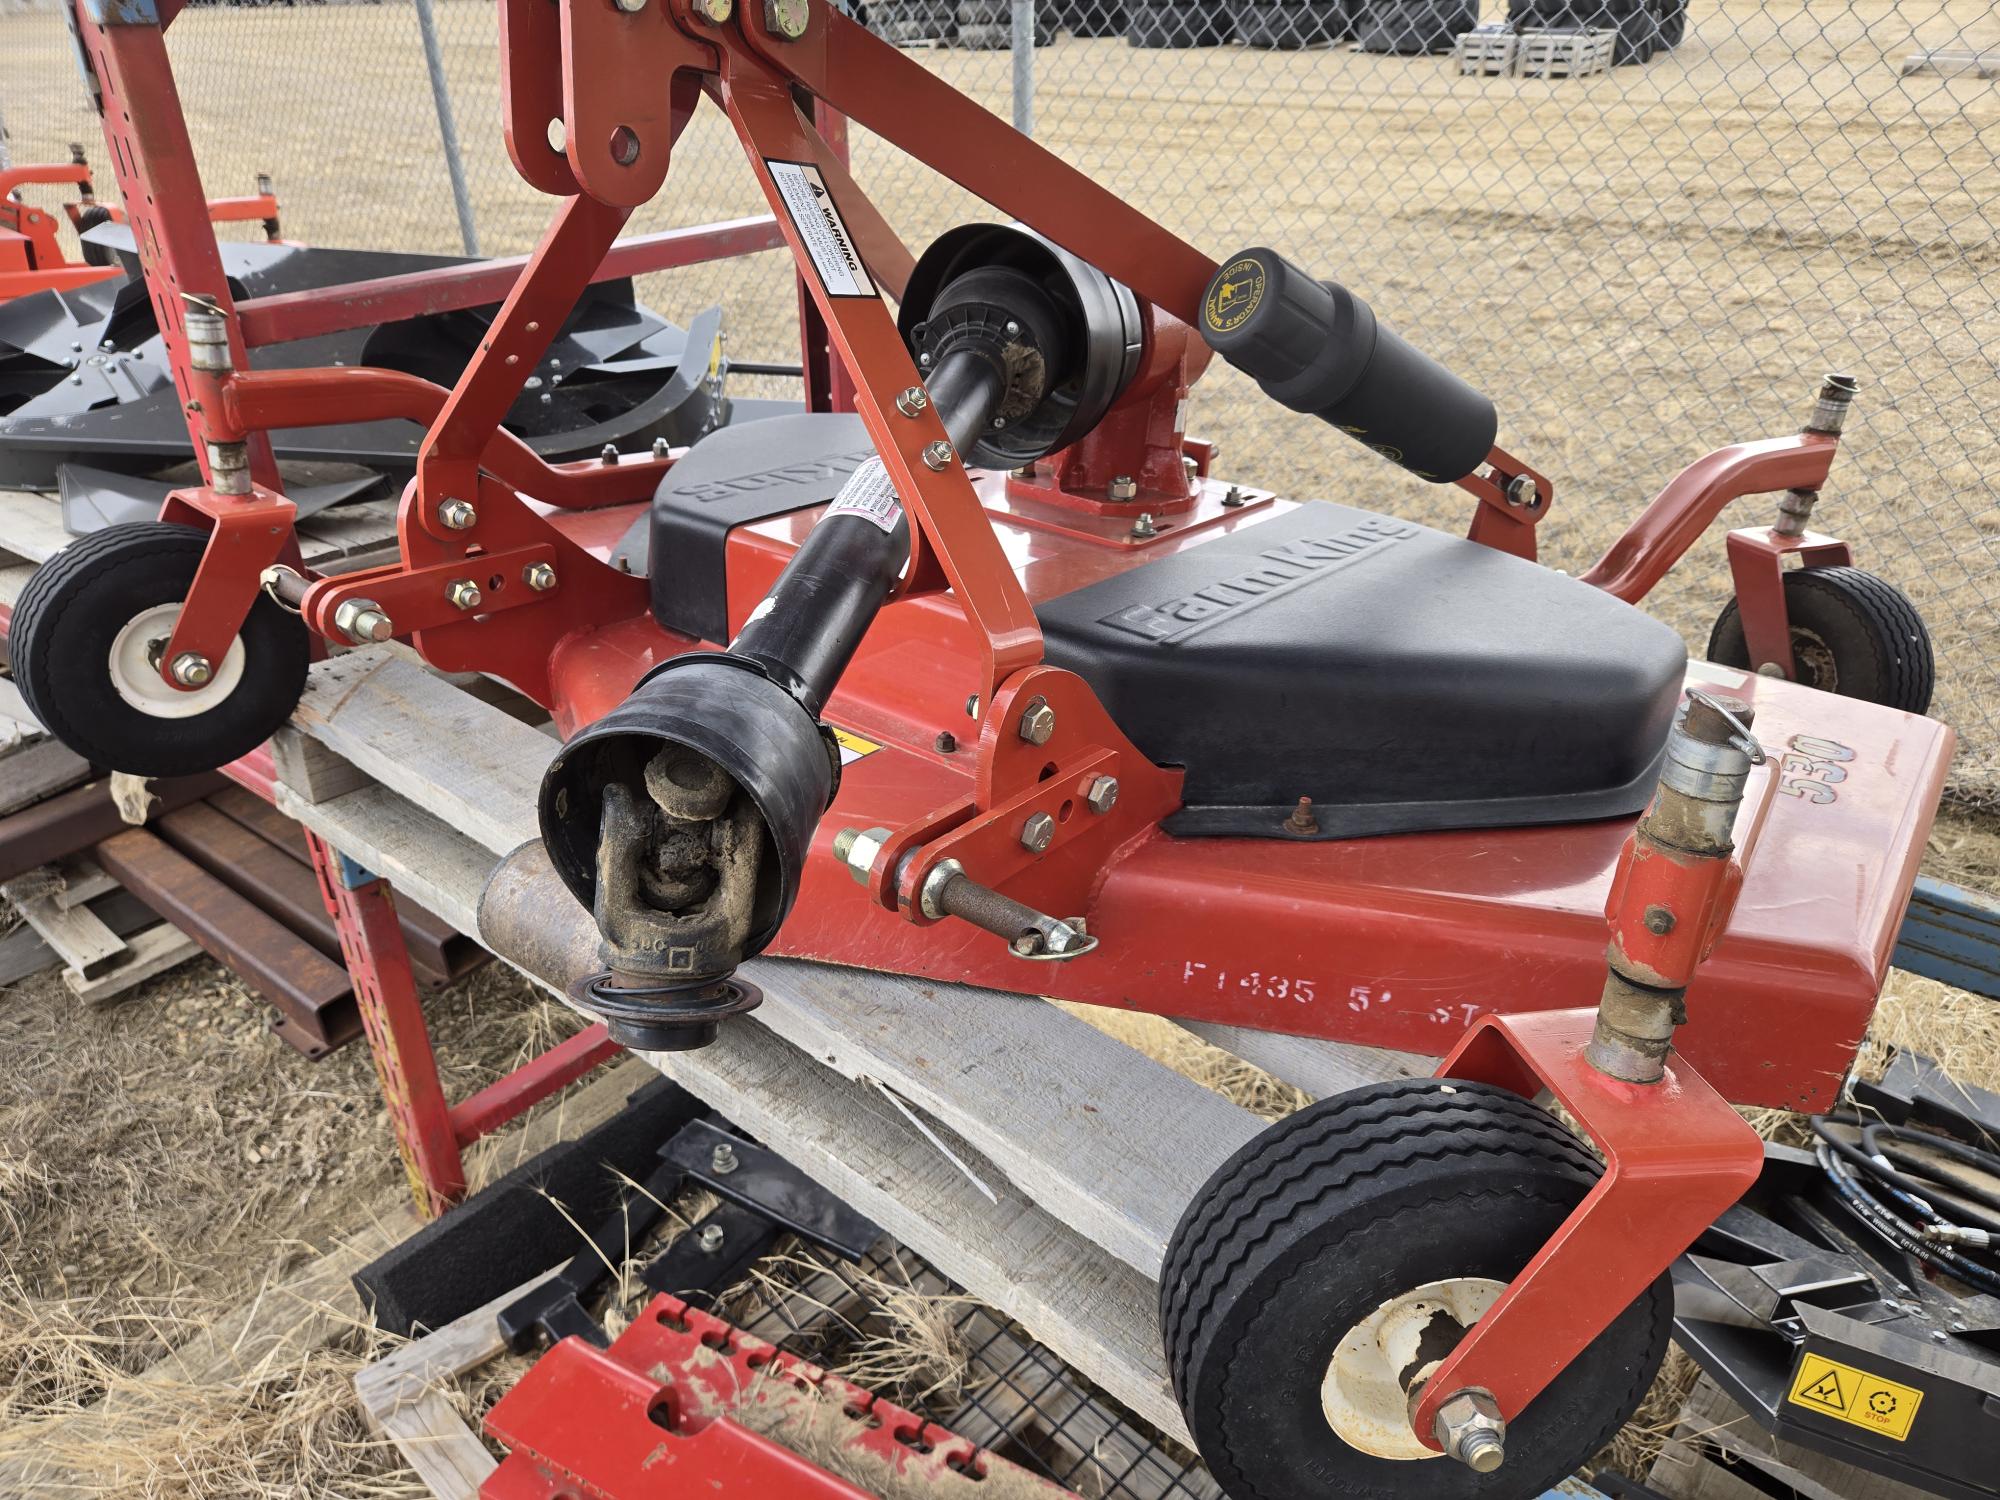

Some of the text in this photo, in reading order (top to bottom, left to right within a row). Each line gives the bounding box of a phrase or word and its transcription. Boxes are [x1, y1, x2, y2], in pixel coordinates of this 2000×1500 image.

[777, 171, 796, 200] BOTTOM
[791, 173, 808, 199] BEFORE
[823, 240, 845, 276] LOWERING
[822, 208, 858, 272] WARNING
[825, 257, 836, 271] NOT
[1223, 264, 1252, 281] INSIDE
[1208, 276, 1262, 327] OPERATOR'S MANUAL
[1779, 734, 1857, 804] 530
[1872, 1217, 1896, 1238] WINNER
[1864, 1411, 1890, 1424] STOP
